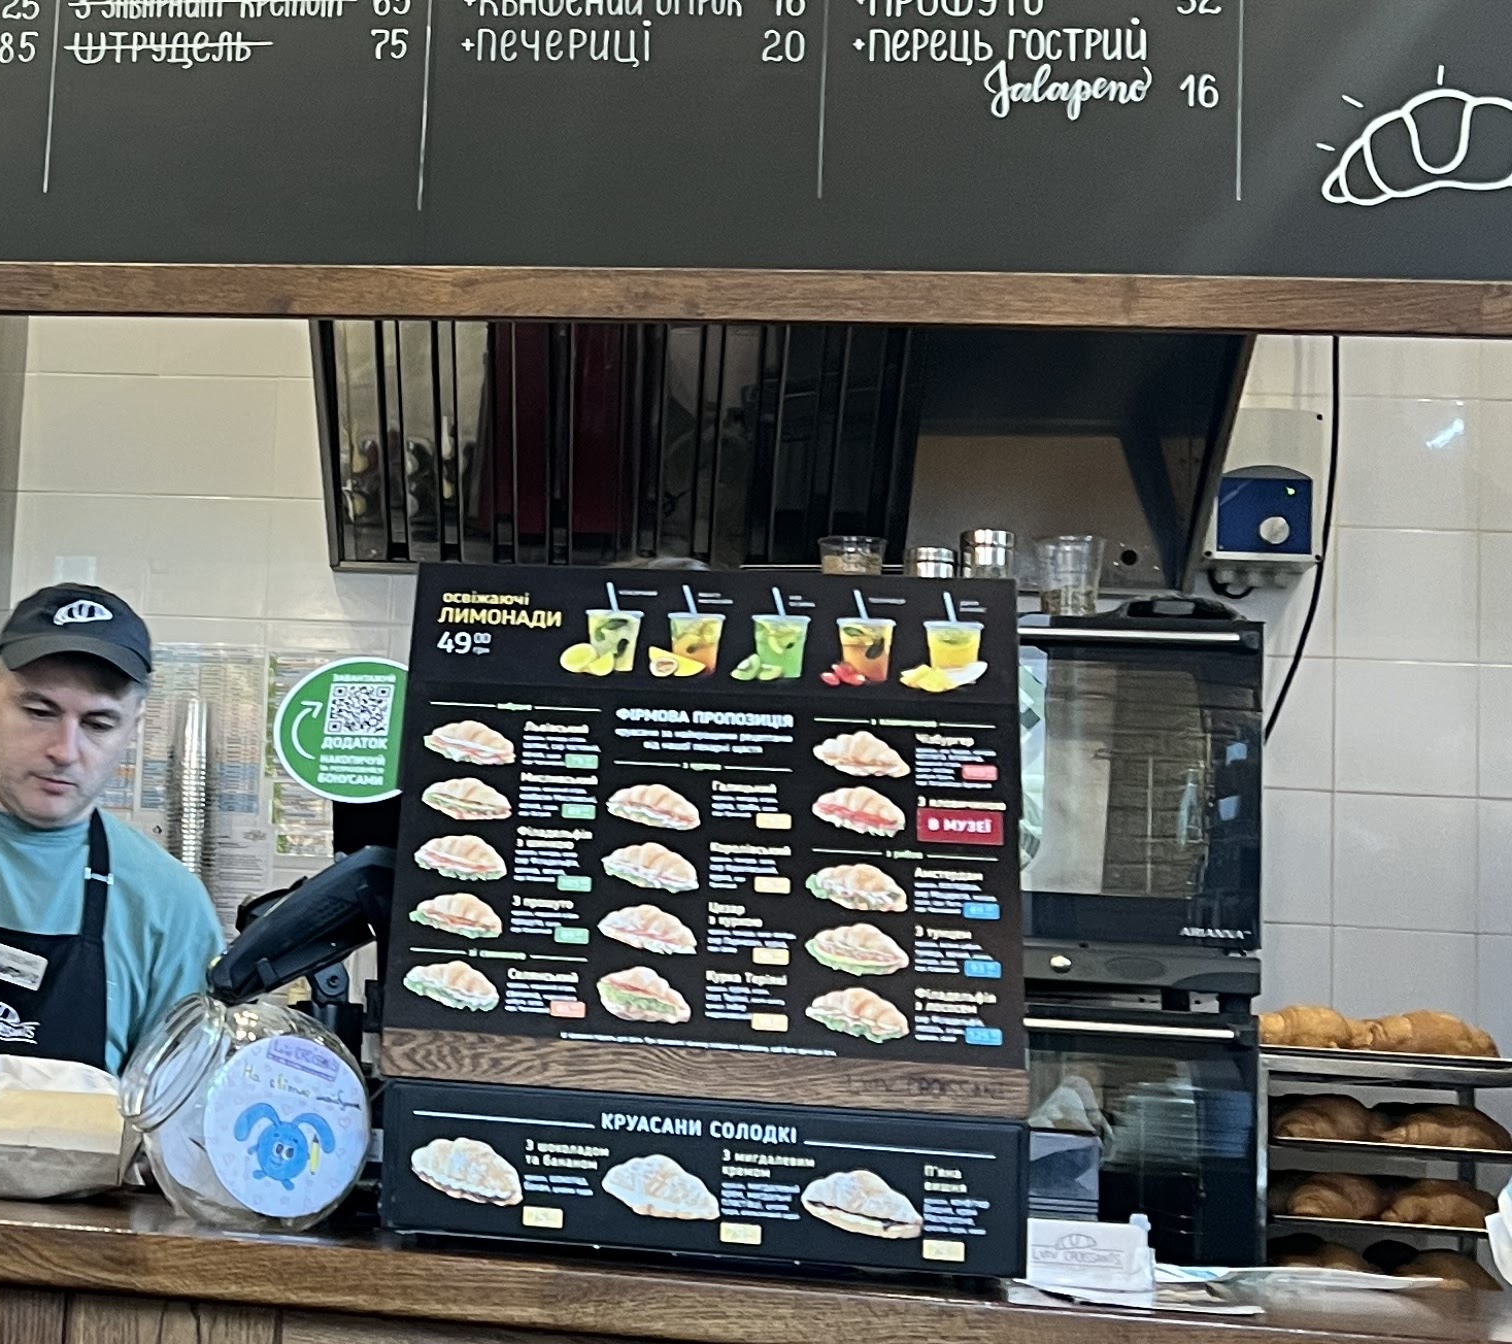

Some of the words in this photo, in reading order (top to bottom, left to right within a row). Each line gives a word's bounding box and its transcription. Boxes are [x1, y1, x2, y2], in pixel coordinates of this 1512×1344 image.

[1008, 18, 1146, 61] ГОСТРИЙ
[984, 60, 1152, 120] Jalapeno
[1180, 74, 1218, 107] 16
[442, 591, 530, 605] освіжаючі
[437, 607, 562, 629] ЛИМОНАДИ
[437, 630, 472, 654] 49
[692, 710, 795, 729] ПРОПОЗИЦІЯ
[320, 736, 389, 750] ДОДАТОК
[943, 818, 993, 834] МУЗЕЇ
[601, 1112, 702, 1137] КРУАСАНИ
[709, 1120, 797, 1145] СОЛОДКІ
